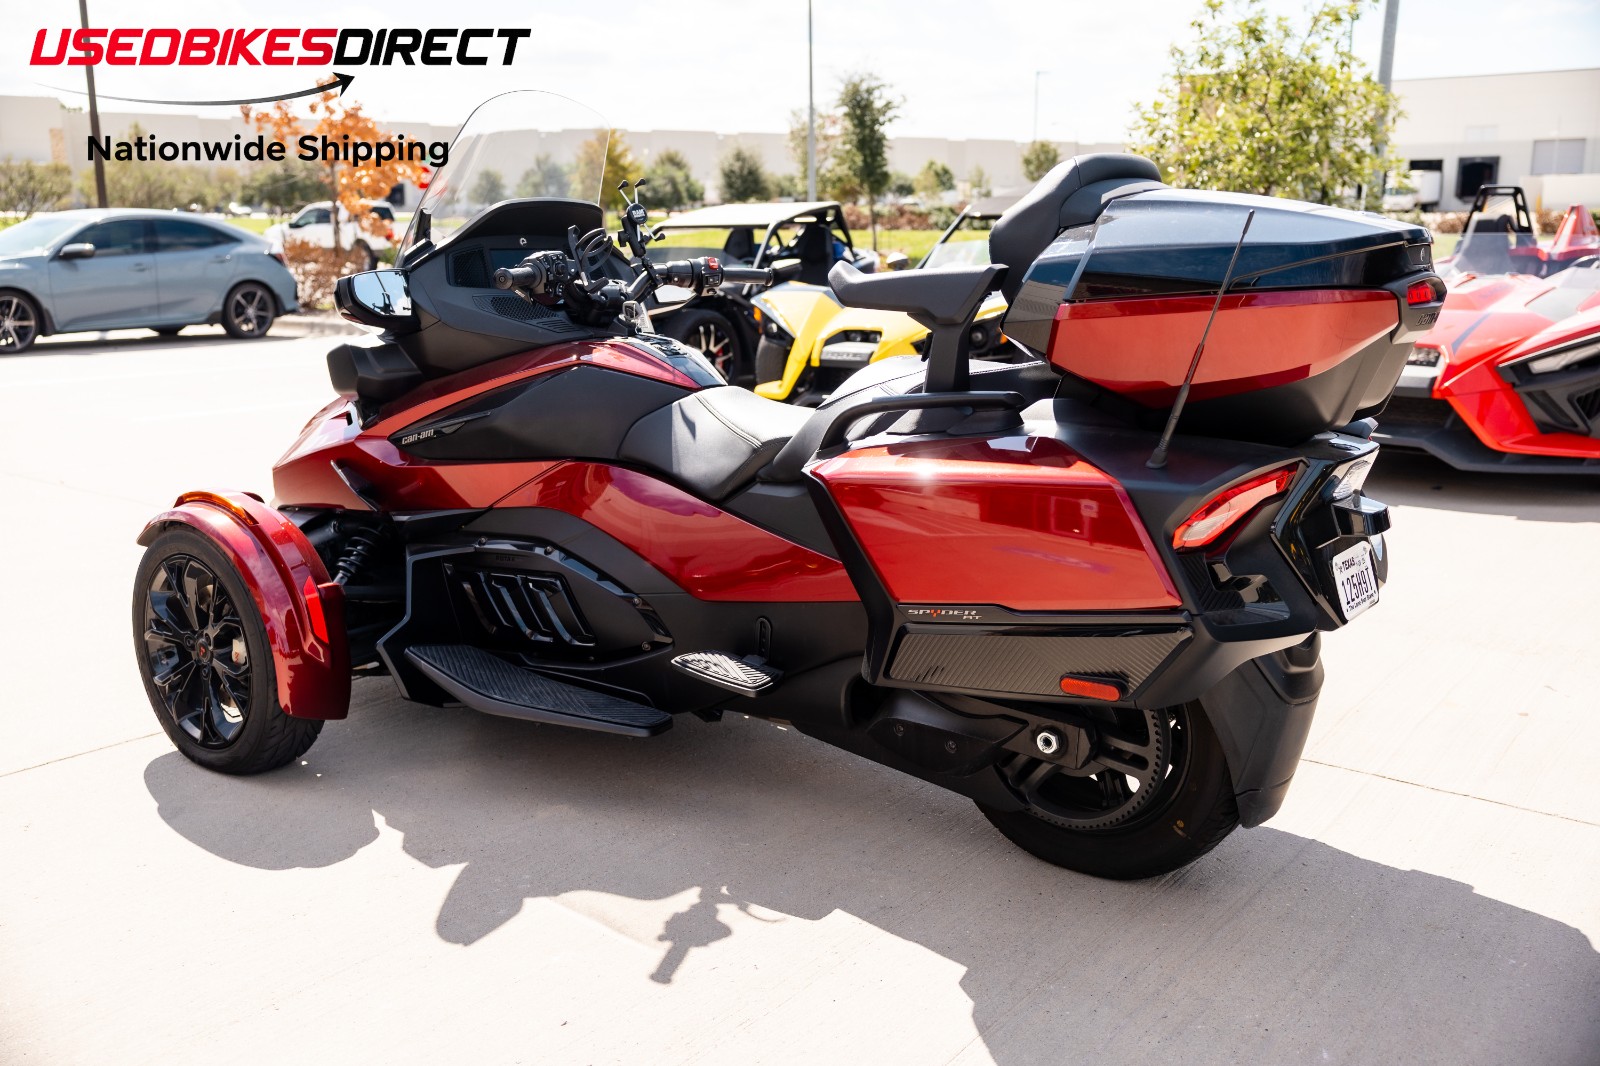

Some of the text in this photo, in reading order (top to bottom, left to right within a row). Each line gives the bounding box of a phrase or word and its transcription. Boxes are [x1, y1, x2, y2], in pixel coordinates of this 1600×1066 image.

[401, 428, 434, 445] can-am
[1341, 556, 1356, 571] TEXAS
[1342, 567, 1373, 606] 125H9T
[908, 609, 976, 617] SPYDER
